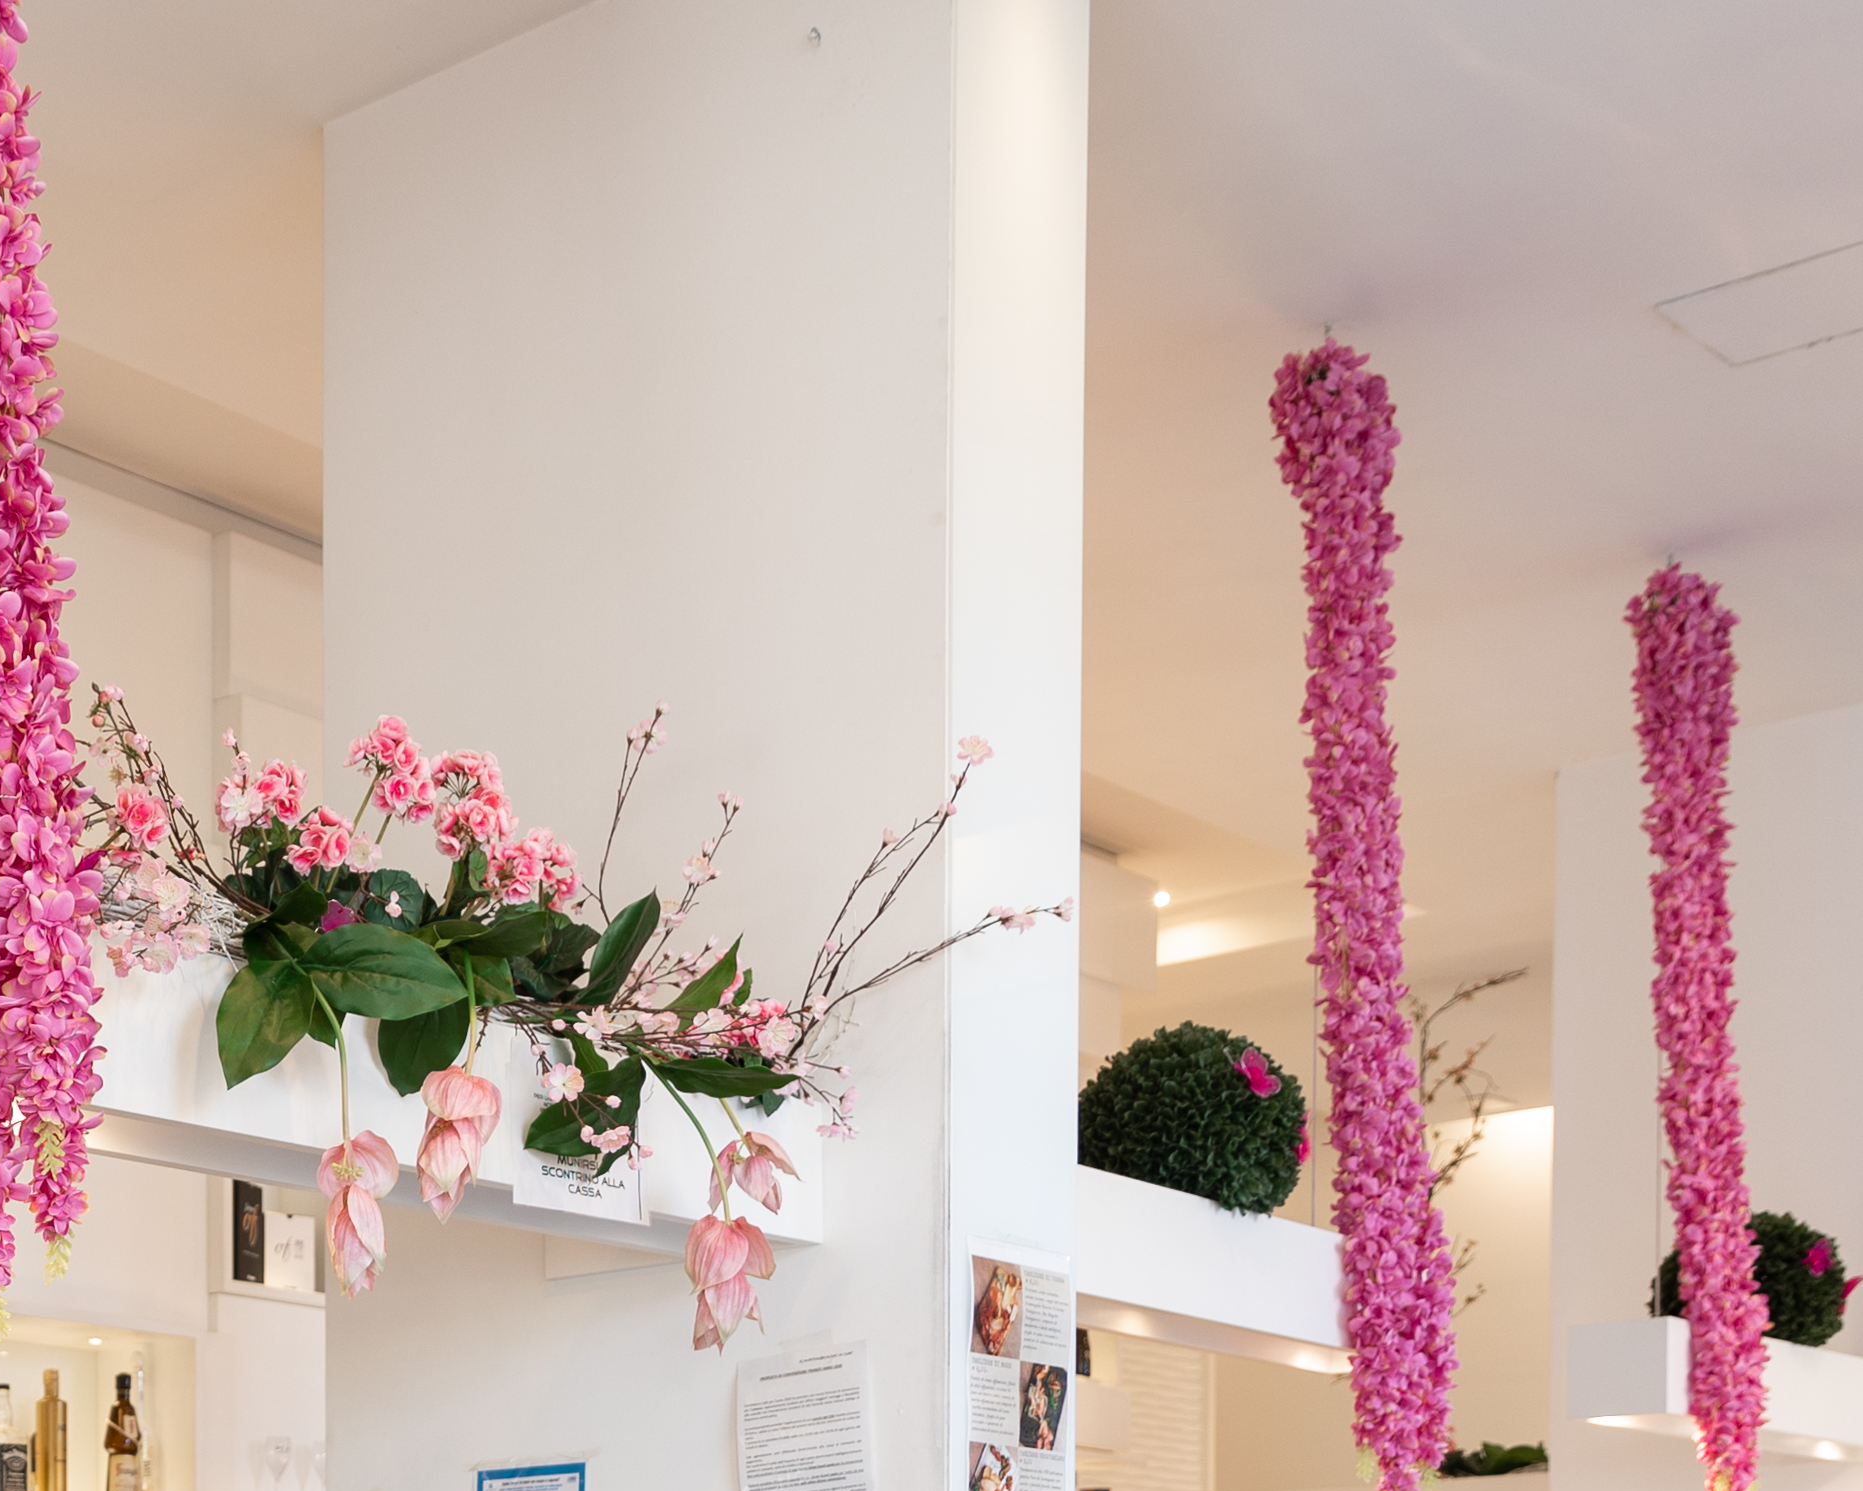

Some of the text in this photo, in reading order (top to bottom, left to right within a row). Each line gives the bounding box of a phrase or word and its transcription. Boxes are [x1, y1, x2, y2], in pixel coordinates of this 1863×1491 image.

[542, 1165, 625, 1189] SCONTRINO ALLA
[568, 1184, 602, 1198] CASSA
